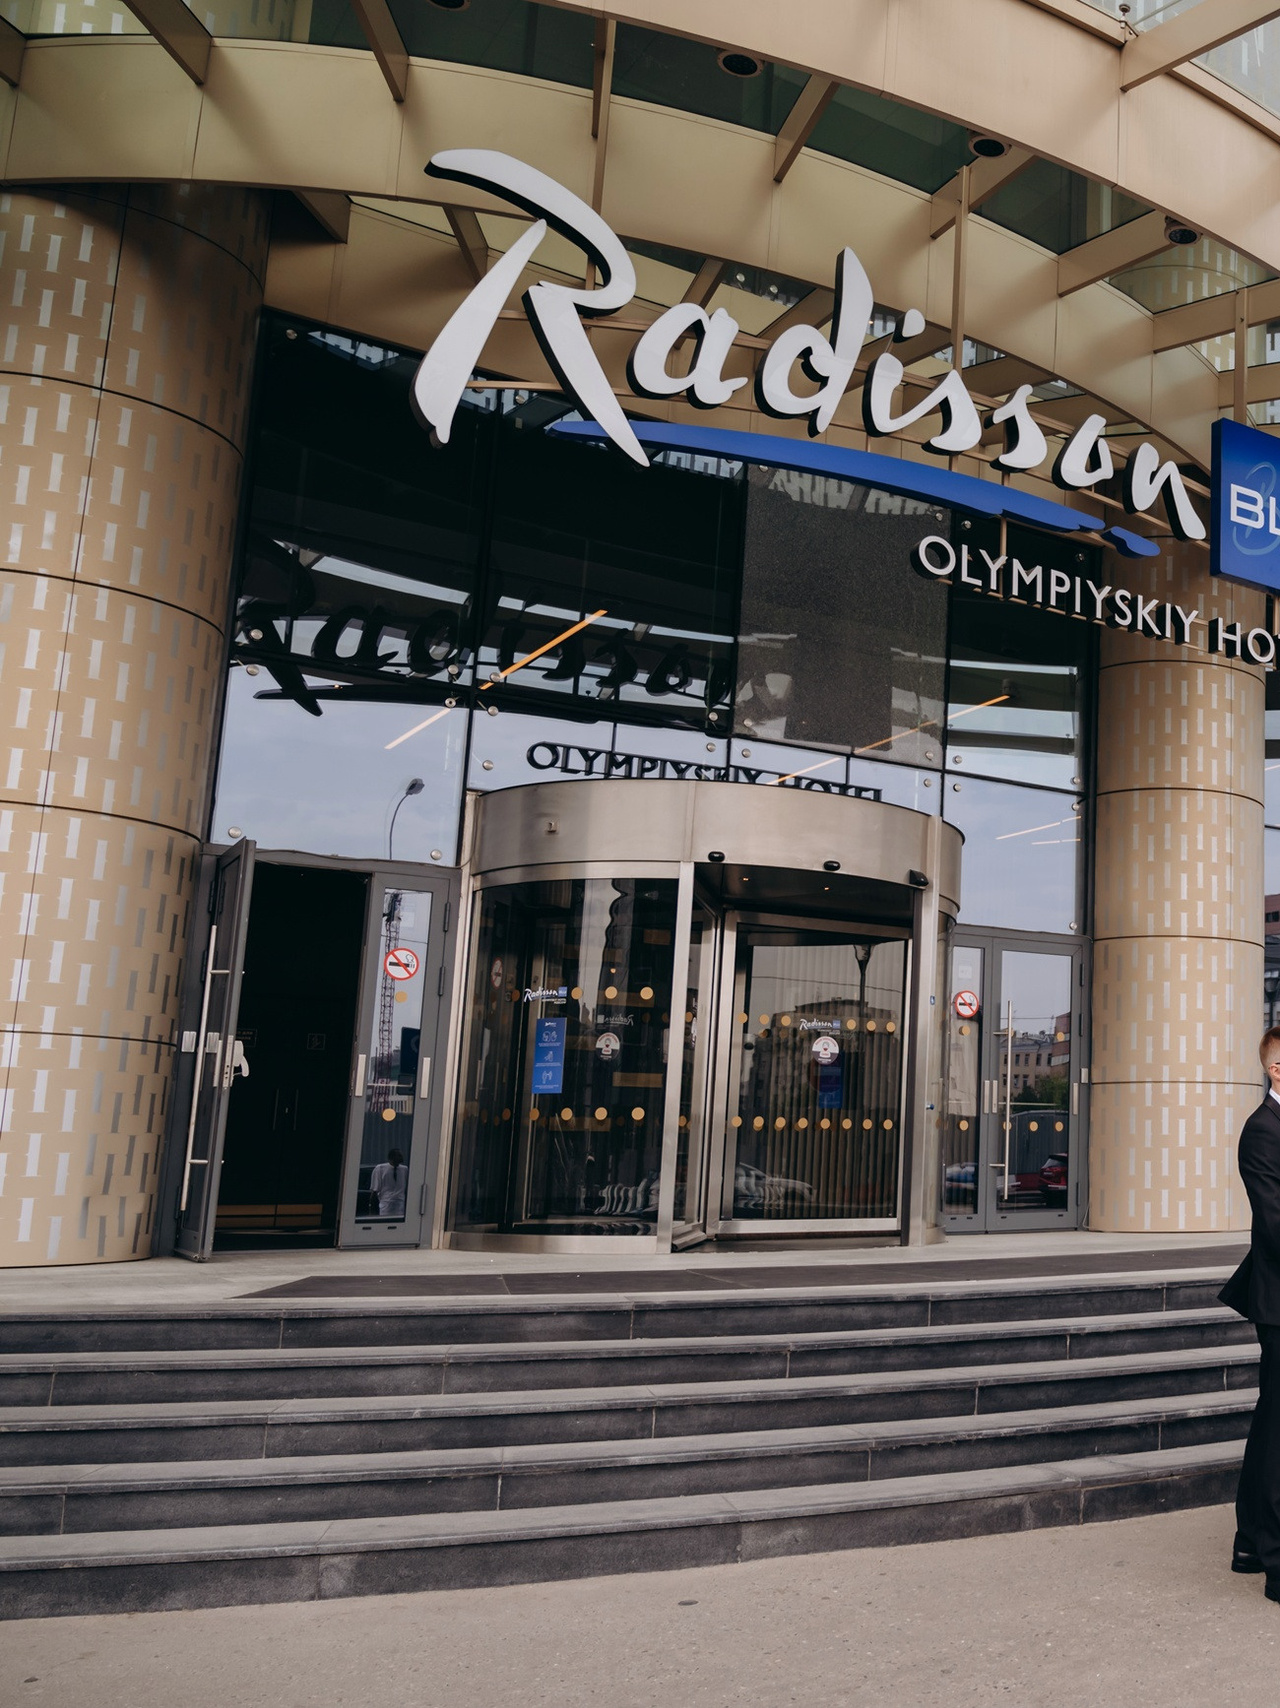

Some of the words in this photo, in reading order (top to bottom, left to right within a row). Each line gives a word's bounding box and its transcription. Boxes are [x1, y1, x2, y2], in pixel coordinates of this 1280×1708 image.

[411, 149, 1207, 541] Radisson
[914, 535, 1199, 645] OLYMPIYSKIY
[524, 986, 558, 1002] Radisson
[800, 1018, 833, 1031] Radisson
